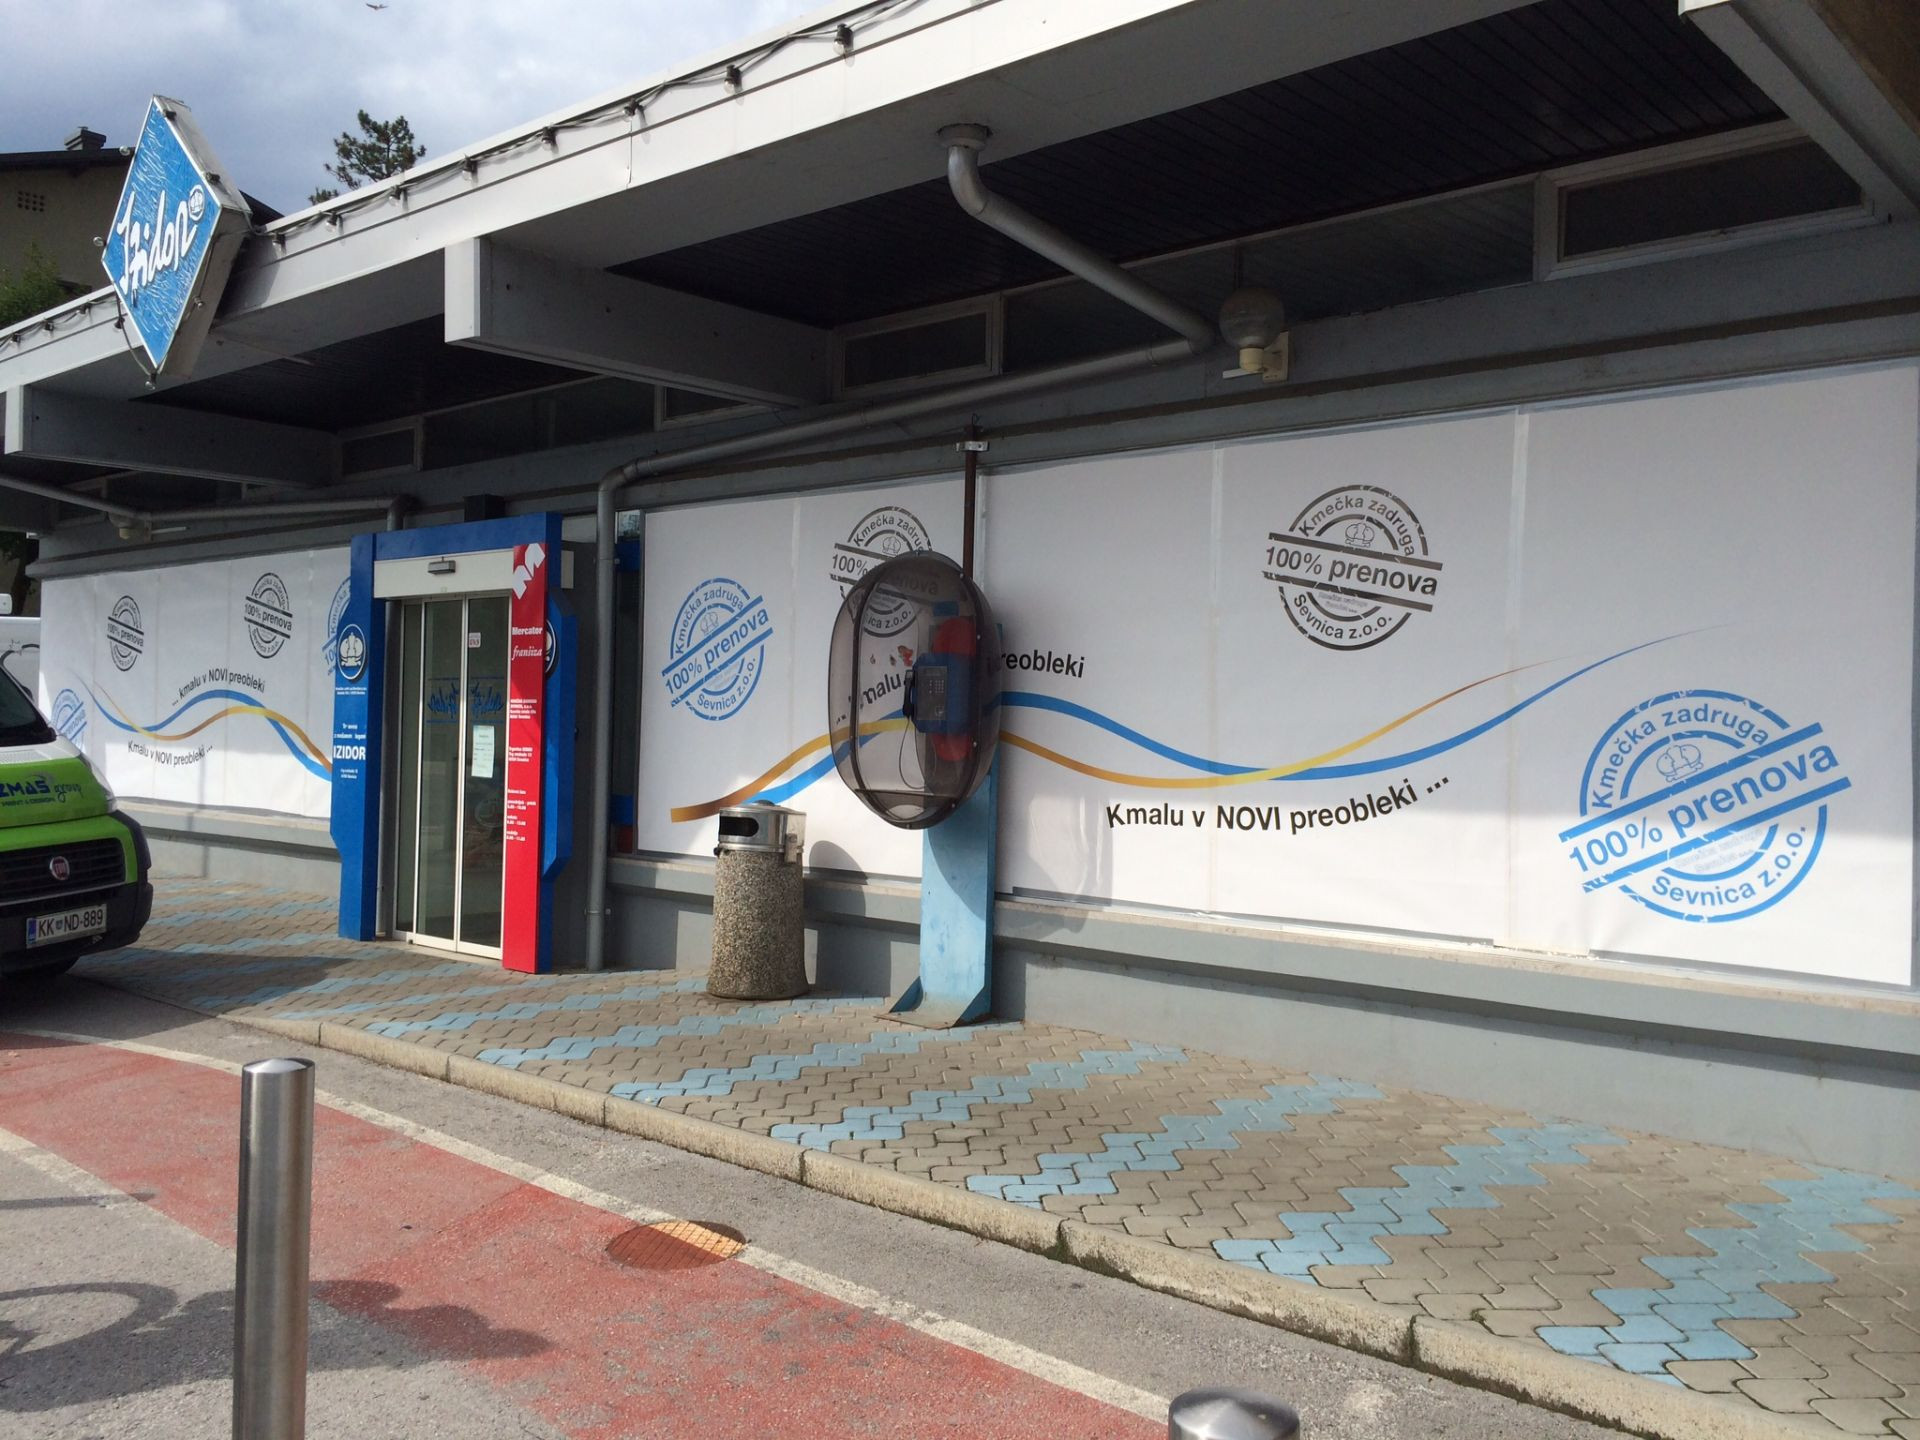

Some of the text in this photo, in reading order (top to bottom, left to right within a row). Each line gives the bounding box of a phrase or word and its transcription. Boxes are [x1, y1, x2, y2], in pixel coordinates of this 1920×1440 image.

[853, 514, 894, 547] Kmečka
[1299, 495, 1415, 556] Kmečka zadruga
[832, 554, 868, 577] 100%
[1266, 546, 1438, 596] 100% prenova
[244, 604, 293, 631] 100% prenova
[512, 626, 543, 636] Mercator
[675, 586, 744, 654] Kmečka zadruga
[1294, 594, 1344, 639] Sevnica
[1348, 617, 1392, 640] z.o.o.
[665, 658, 702, 694] 100%
[704, 608, 769, 669] prenova
[990, 649, 1085, 679] reobleki
[202, 674, 207, 684] v
[208, 668, 228, 681] NOVI
[228, 671, 265, 693] preobleki
[697, 693, 737, 711] Sevnica
[737, 658, 756, 696] z.o.o.
[128, 741, 149, 758] Kmalu
[150, 751, 155, 760] v
[155, 751, 173, 766] NOVI
[173, 744, 206, 768] preobleki
[333, 745, 366, 761] IZIDOR
[1591, 703, 1769, 809] Kmečka zadruga
[1106, 802, 1184, 829] Kmalu
[1192, 811, 1206, 828] v
[1216, 805, 1281, 831] NOVI
[1290, 778, 1418, 835] preobleki
[1569, 816, 1663, 872] 100%
[1668, 744, 1840, 839] prenova
[1652, 875, 1756, 906] Sevnica
[1757, 826, 1806, 888] z.o.o.
[39, 908, 104, 938] KK ND-889
